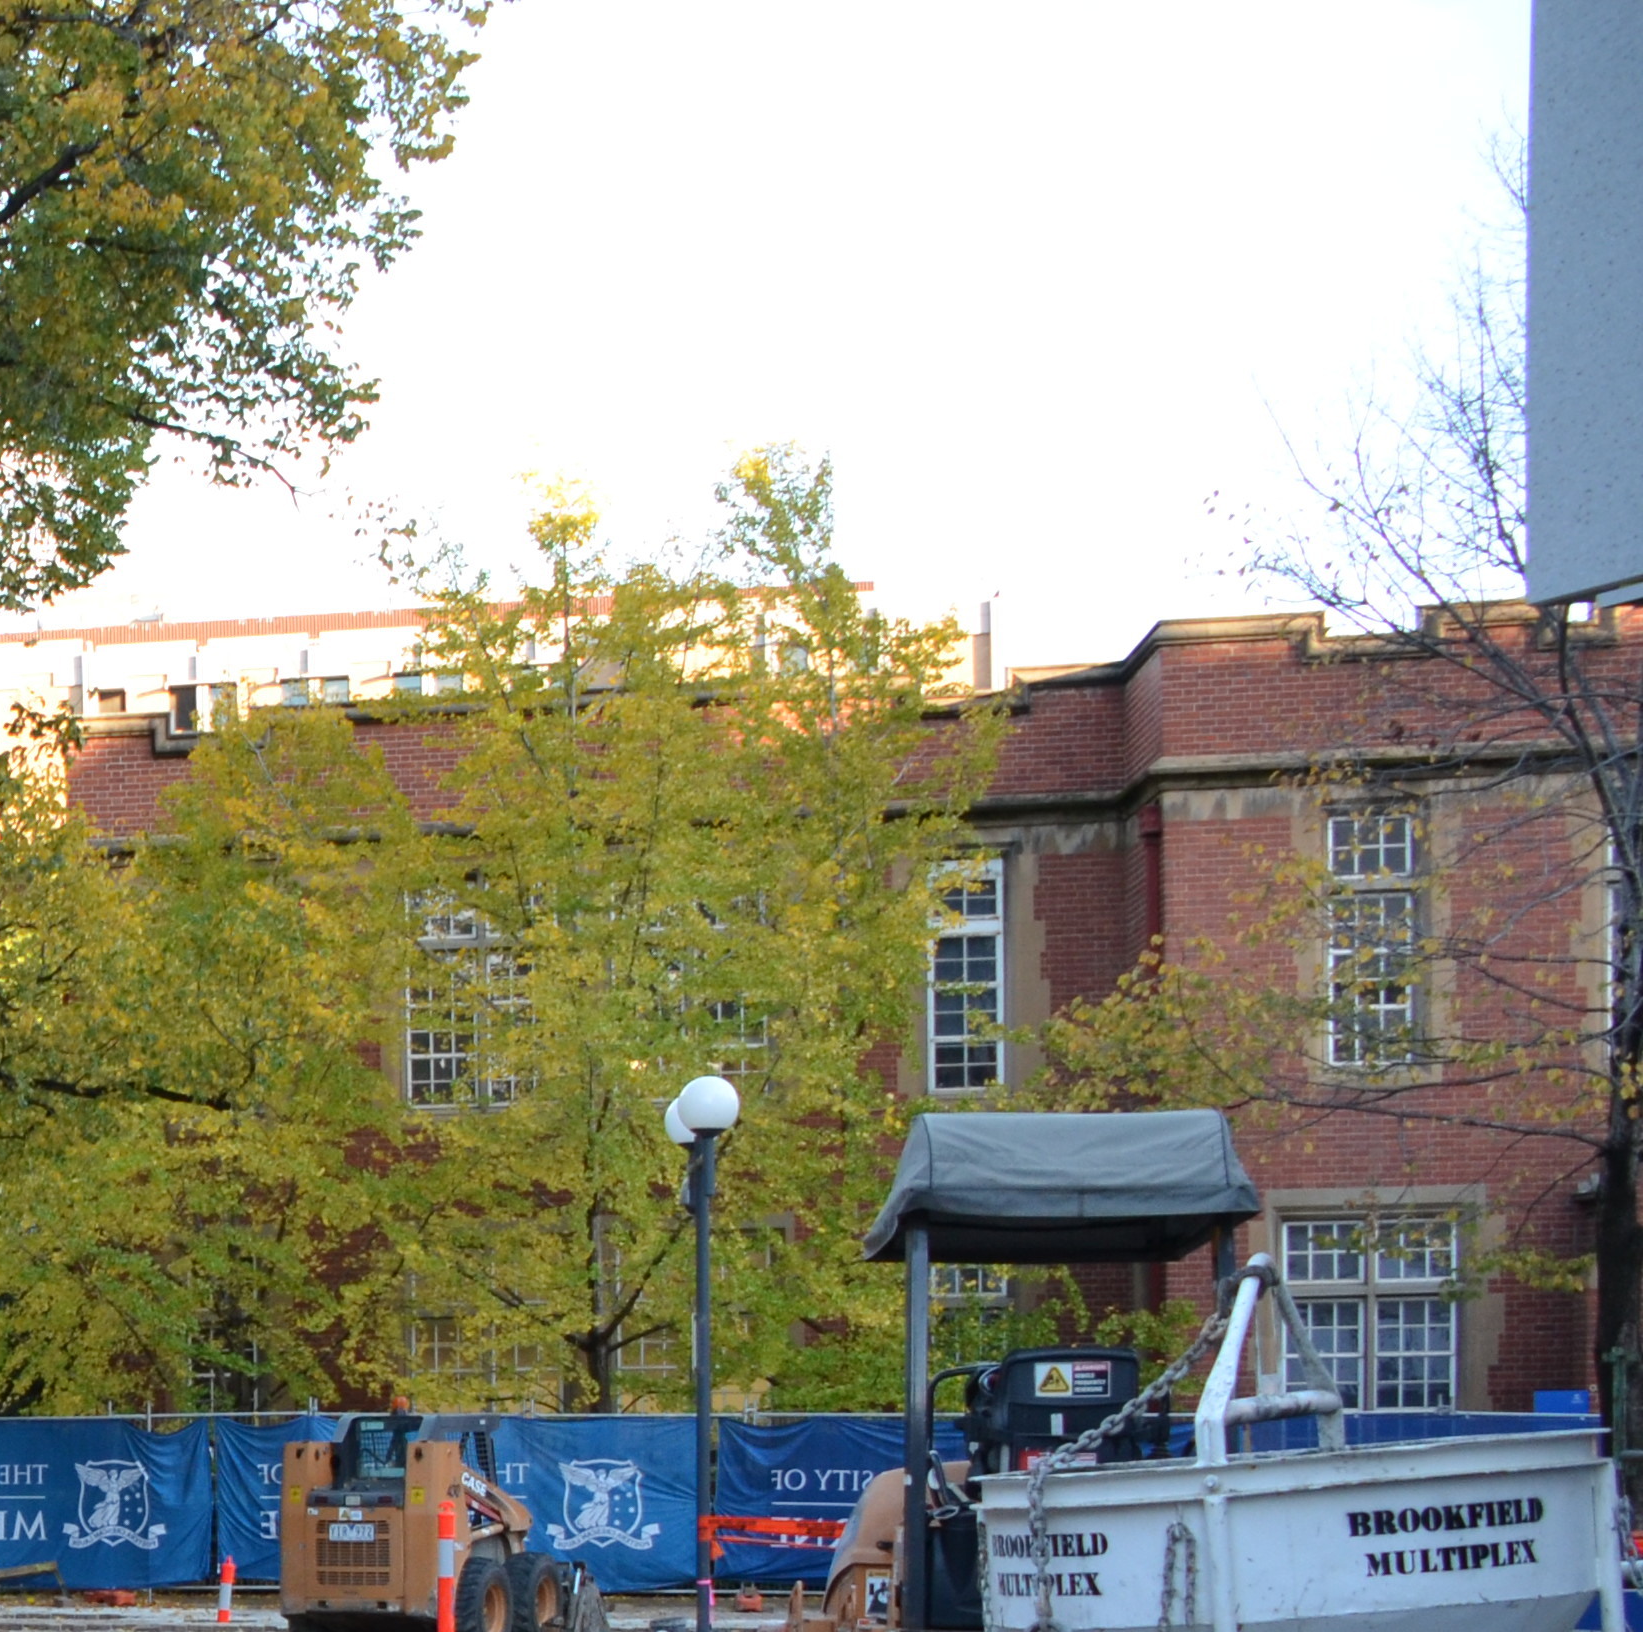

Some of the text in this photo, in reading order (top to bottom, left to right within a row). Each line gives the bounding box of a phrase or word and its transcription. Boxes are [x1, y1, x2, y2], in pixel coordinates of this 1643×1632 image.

[461, 1471, 487, 1497] CASE
[1346, 1497, 1544, 1537] BROOKFIELD
[1364, 1538, 1538, 1577] MULTIPLEX
